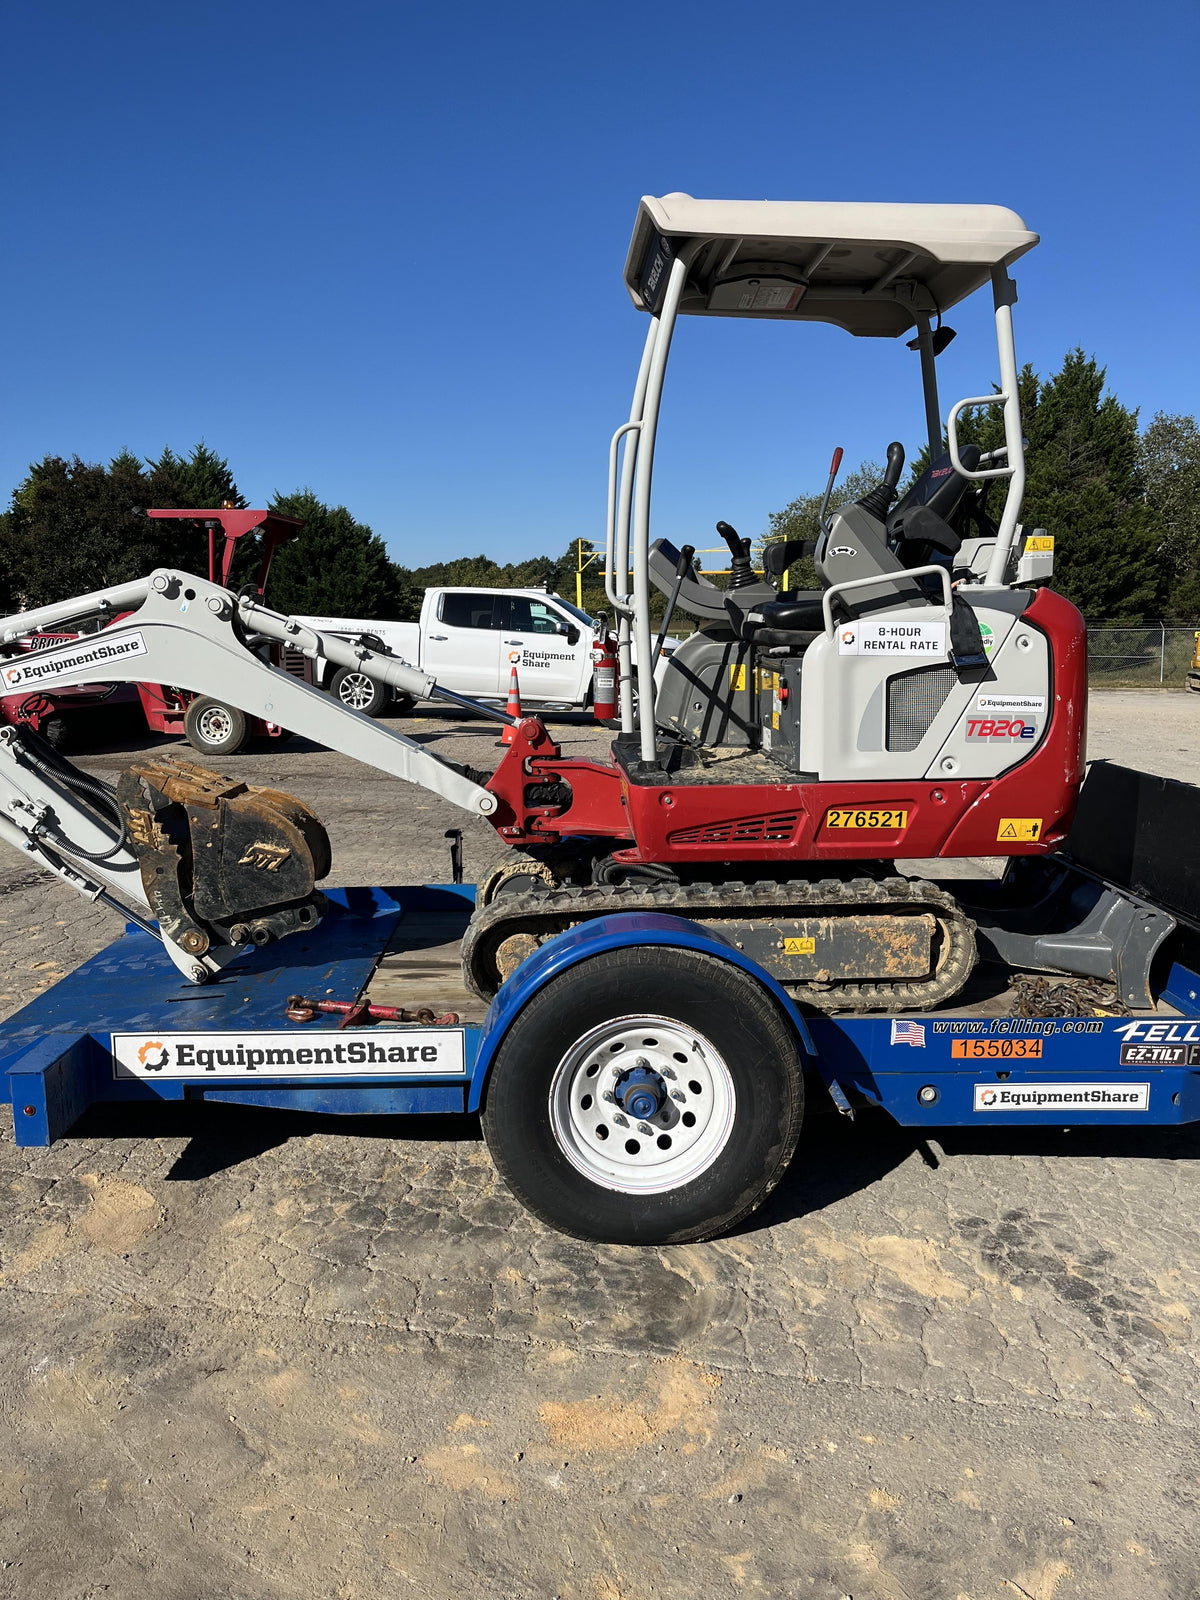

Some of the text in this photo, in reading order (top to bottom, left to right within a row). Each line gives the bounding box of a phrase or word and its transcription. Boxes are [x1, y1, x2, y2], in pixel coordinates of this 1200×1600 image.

[878, 627, 921, 637] 8-HOUR
[864, 640, 938, 650] RENTAL RATE
[23, 641, 139, 679] EquipmentShare
[522, 650, 575, 661] Equipment
[522, 659, 550, 668] Share
[987, 699, 1043, 708] EquipmentShare
[967, 719, 1035, 738] TB20e
[828, 811, 903, 827] 276521
[933, 1019, 1104, 1036] www.felling.com
[1112, 1020, 1200, 1041] FELL
[959, 1039, 1041, 1057] 155034
[1125, 1048, 1183, 1060] EZ-TILT
[176, 1042, 438, 1071] EquipmentShare
[1000, 1090, 1139, 1106] EquipmentShare
